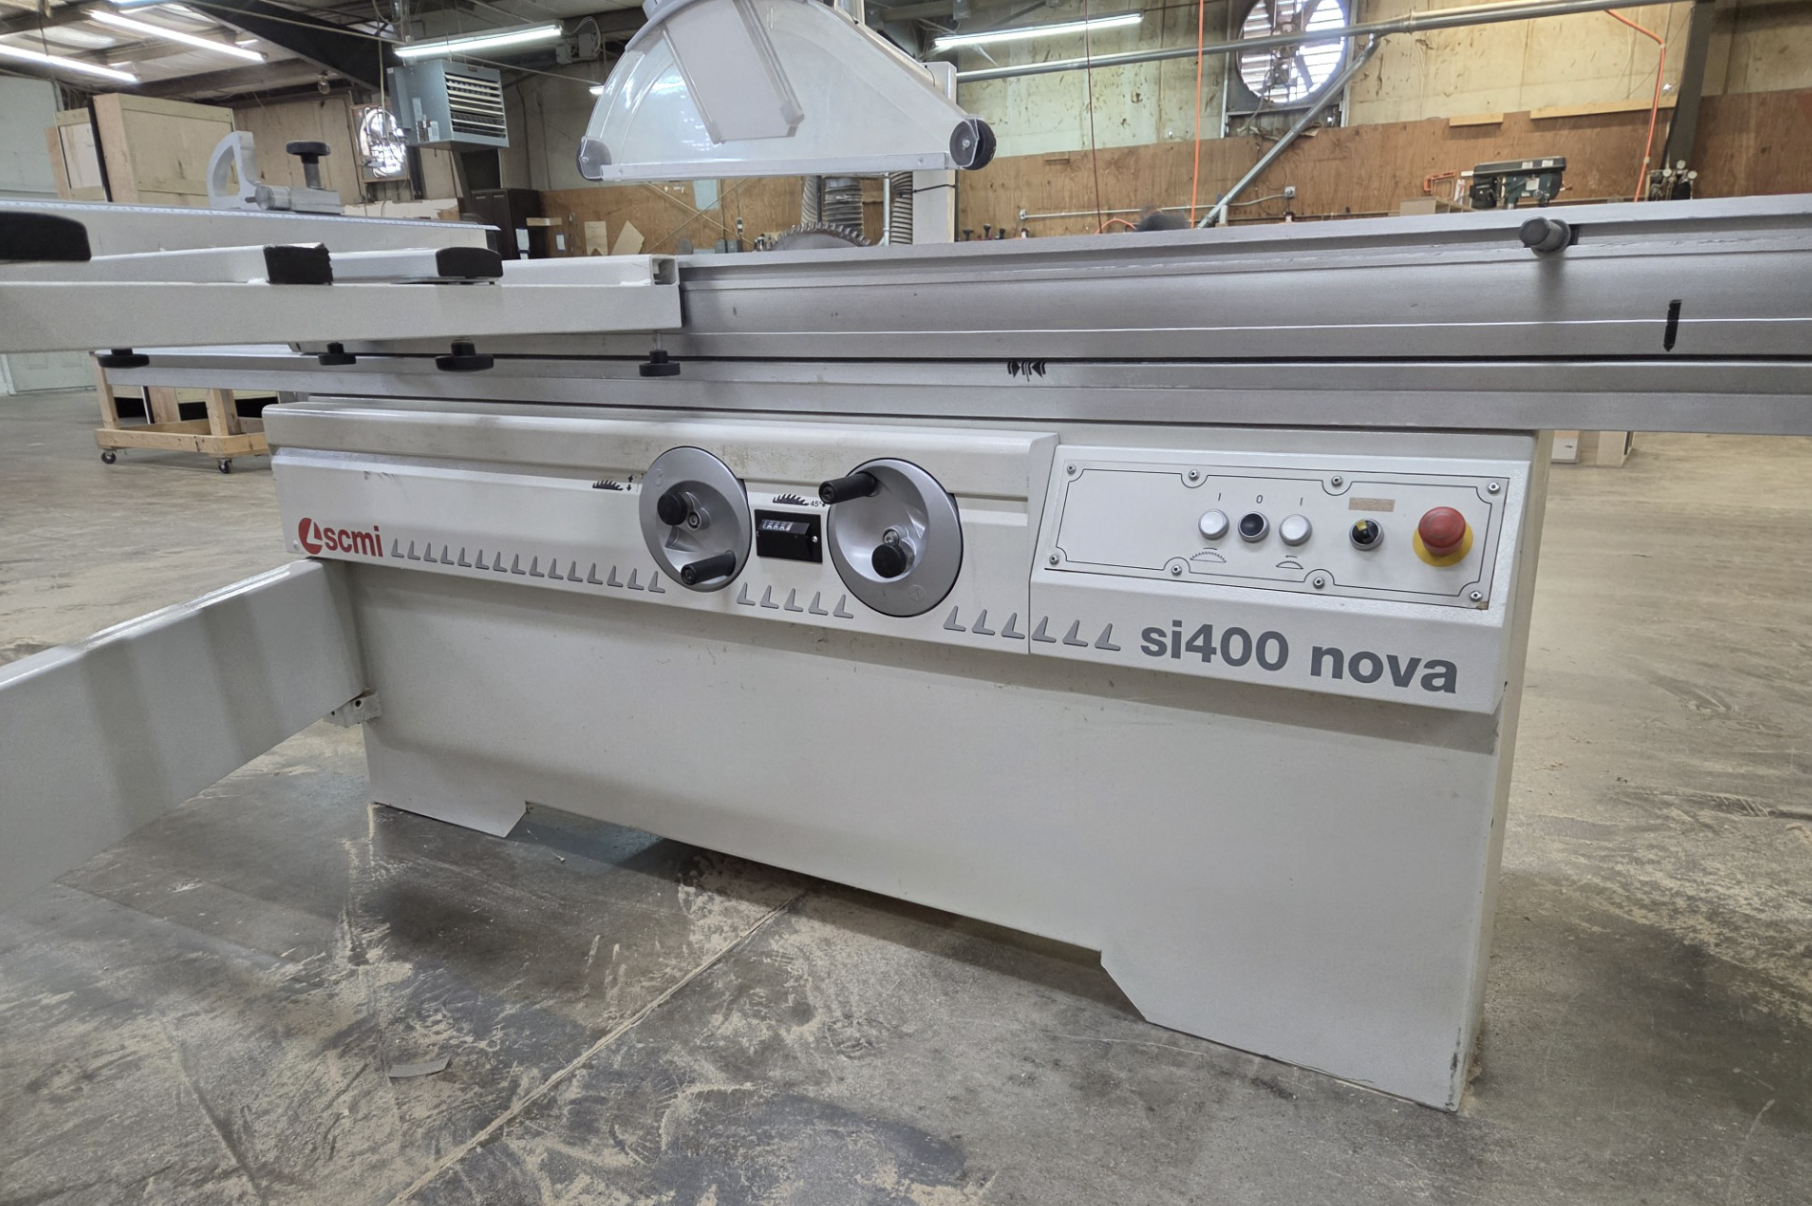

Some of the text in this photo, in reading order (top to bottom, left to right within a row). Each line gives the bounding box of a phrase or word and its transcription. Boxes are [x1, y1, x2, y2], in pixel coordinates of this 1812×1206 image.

[323, 525, 384, 557] scmi
[1140, 619, 1458, 694] si400 nova
